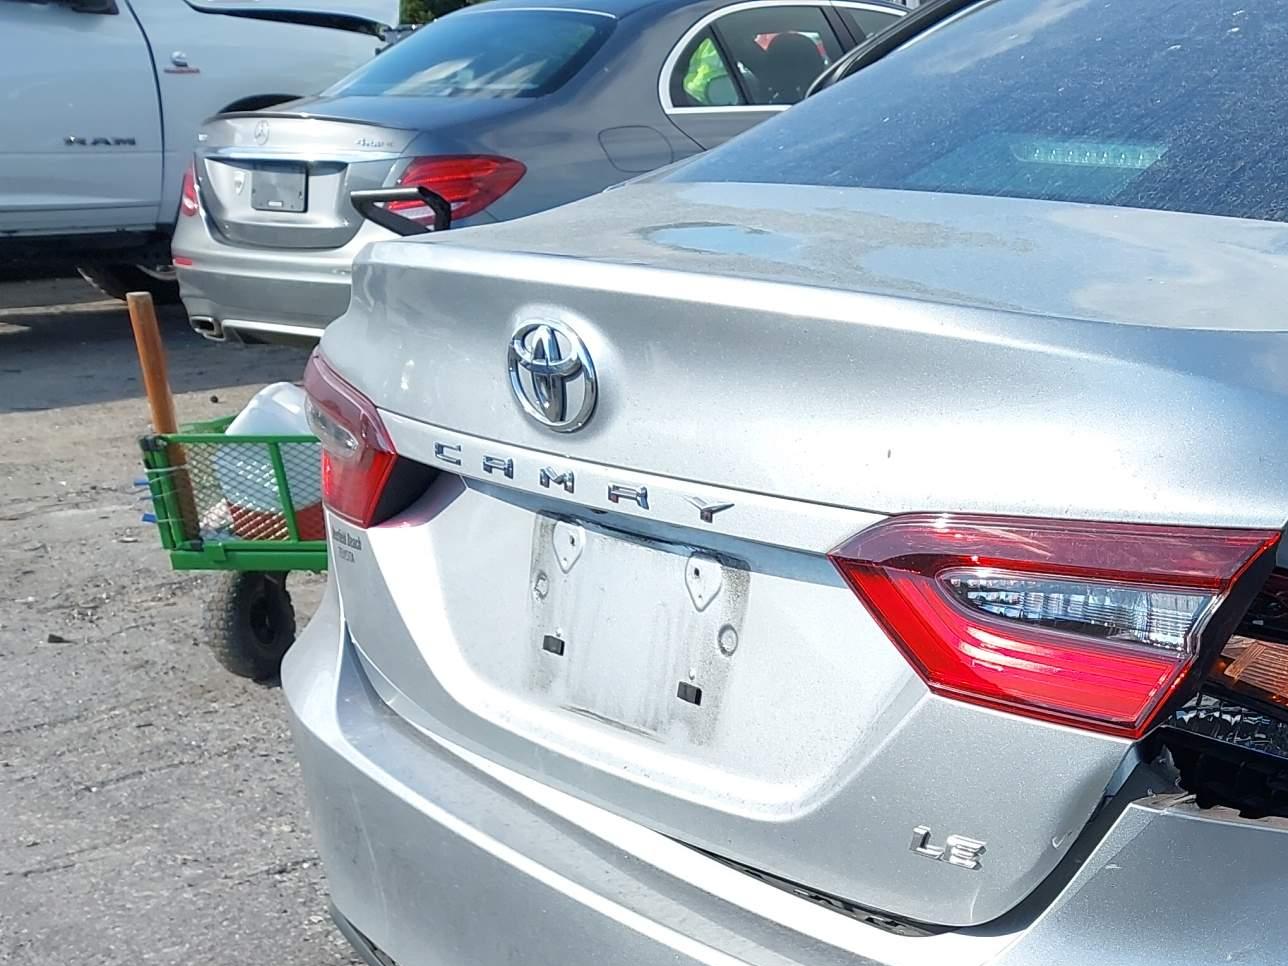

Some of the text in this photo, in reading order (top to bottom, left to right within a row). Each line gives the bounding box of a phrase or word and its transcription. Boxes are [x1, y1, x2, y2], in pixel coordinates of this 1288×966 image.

[64, 135, 137, 146] RAM
[433, 440, 736, 524] CAMRY
[909, 825, 987, 871] LE
